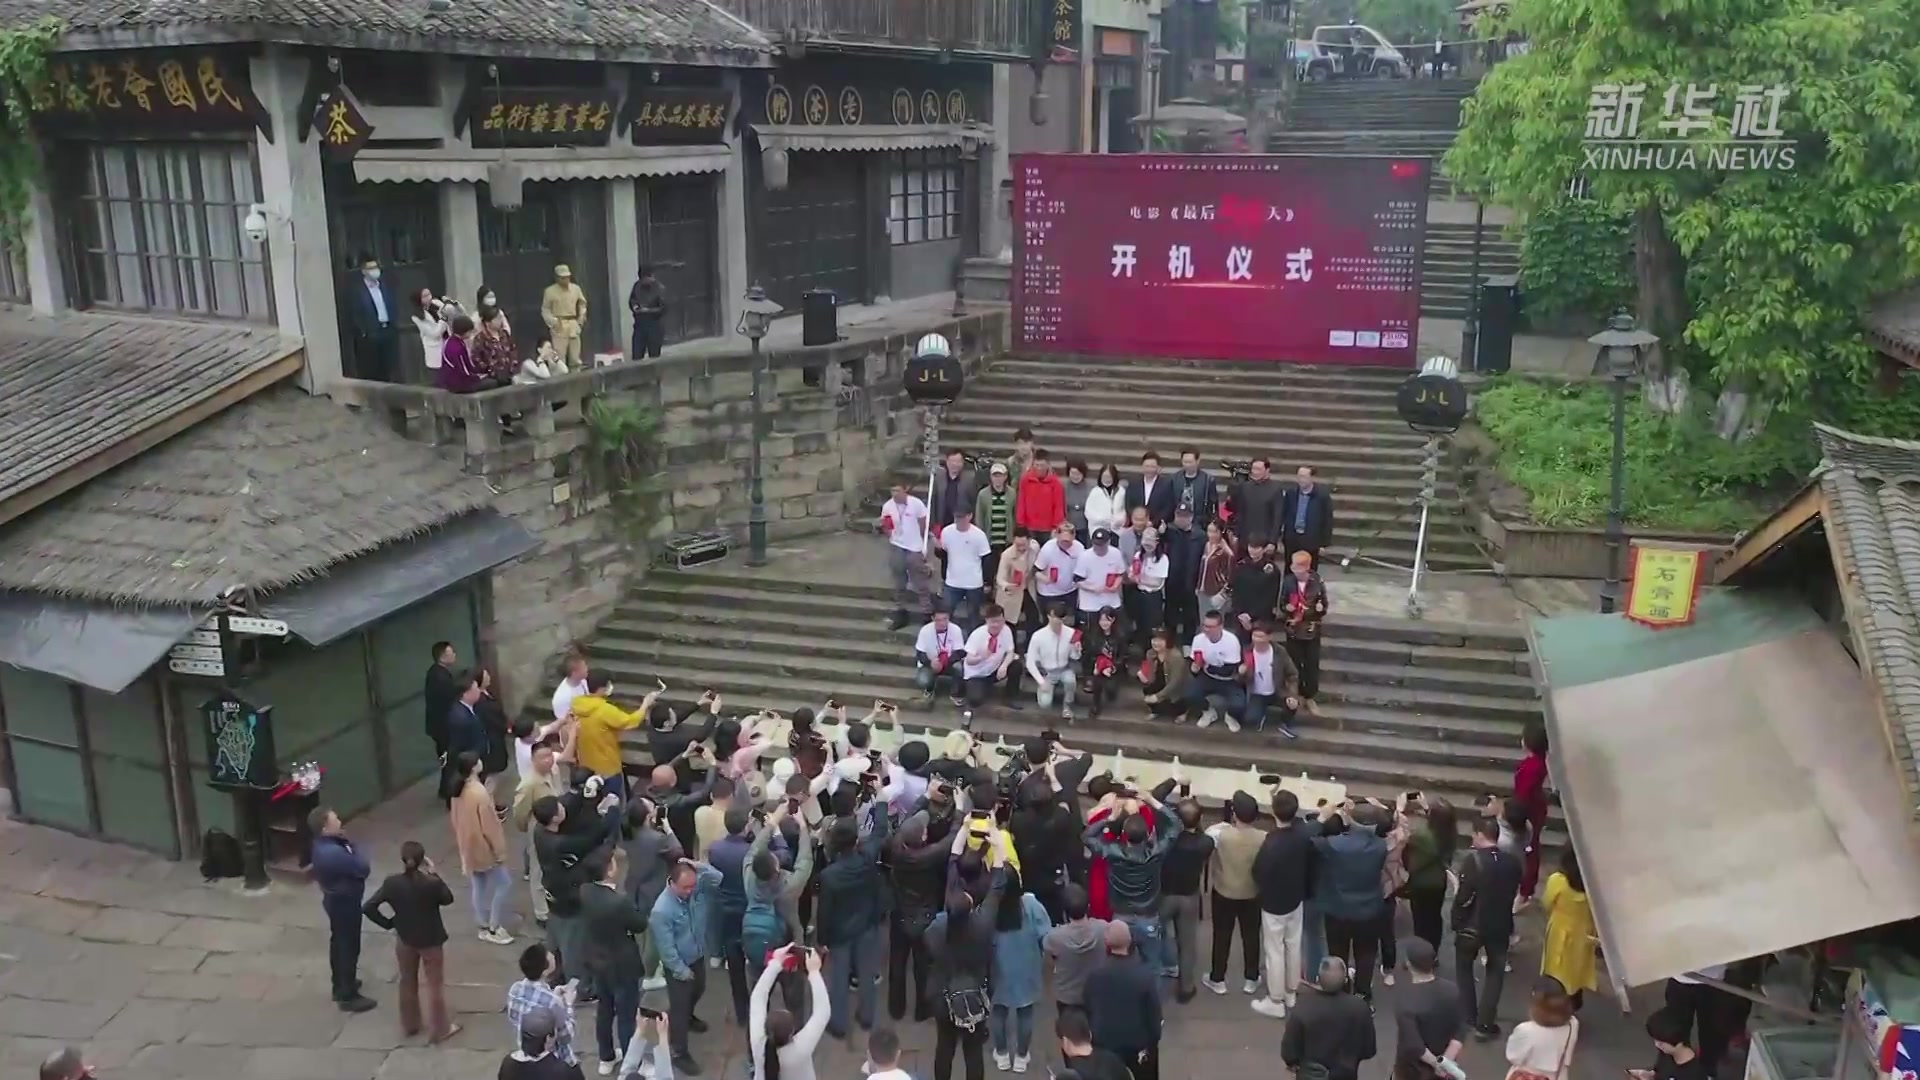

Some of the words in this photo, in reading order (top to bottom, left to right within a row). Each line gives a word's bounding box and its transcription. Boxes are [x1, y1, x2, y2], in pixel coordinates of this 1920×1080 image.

[325, 100, 358, 145] 茶
[1111, 244, 1313, 282] 开机仪式
